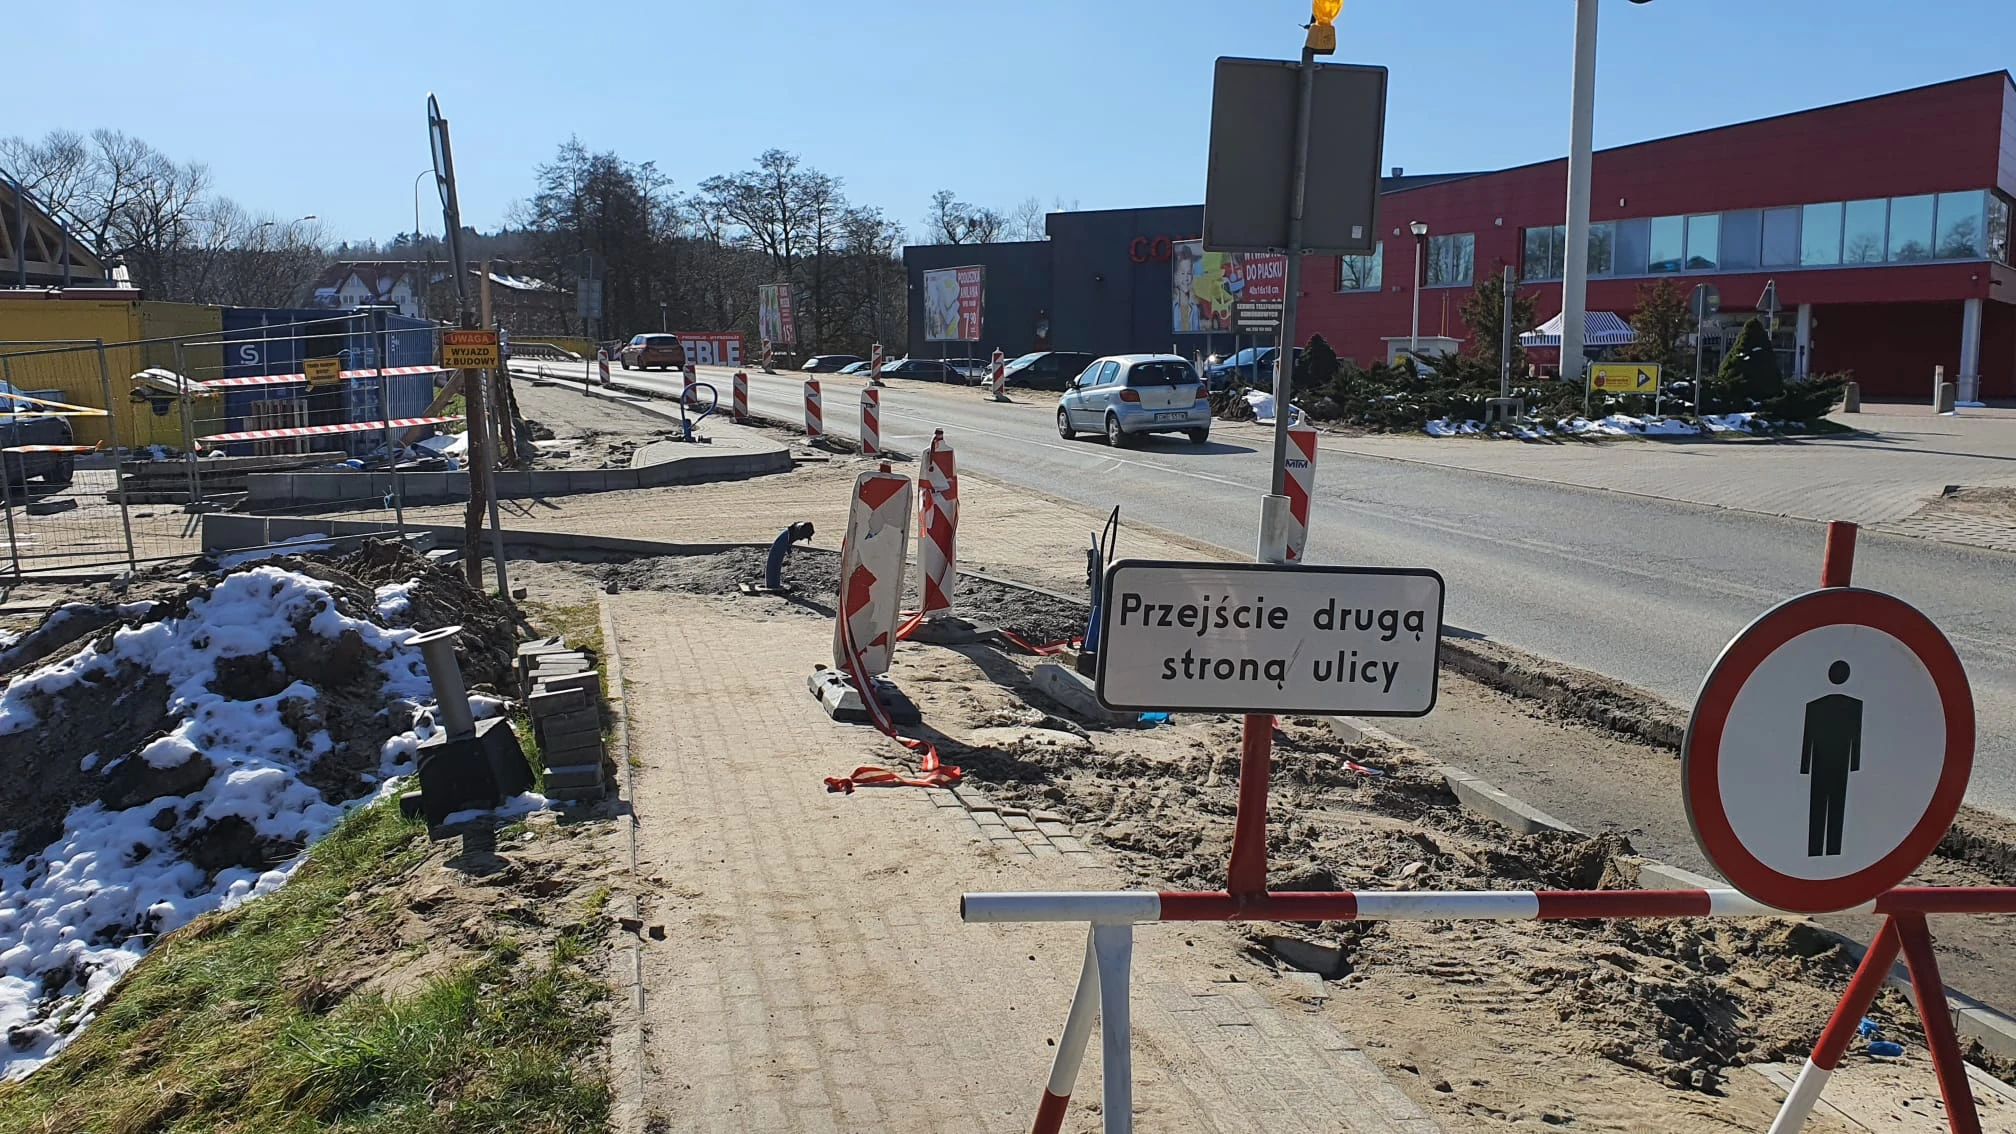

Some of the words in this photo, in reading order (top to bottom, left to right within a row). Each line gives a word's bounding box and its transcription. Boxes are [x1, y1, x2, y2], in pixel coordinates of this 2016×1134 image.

[1246, 265, 1257, 280] DO
[1258, 261, 1283, 279] PIASKU
[450, 334, 489, 344] UWAGA
[451, 348, 490, 356] WYJAZD
[445, 358, 451, 366] Z
[453, 357, 496, 366] BUDOWY
[1285, 459, 1308, 468] MTM
[1120, 593, 1288, 637] Przejście
[1313, 598, 1424, 642] drugą
[1161, 648, 1286, 690] stroną
[1313, 650, 1399, 693] ulicy
